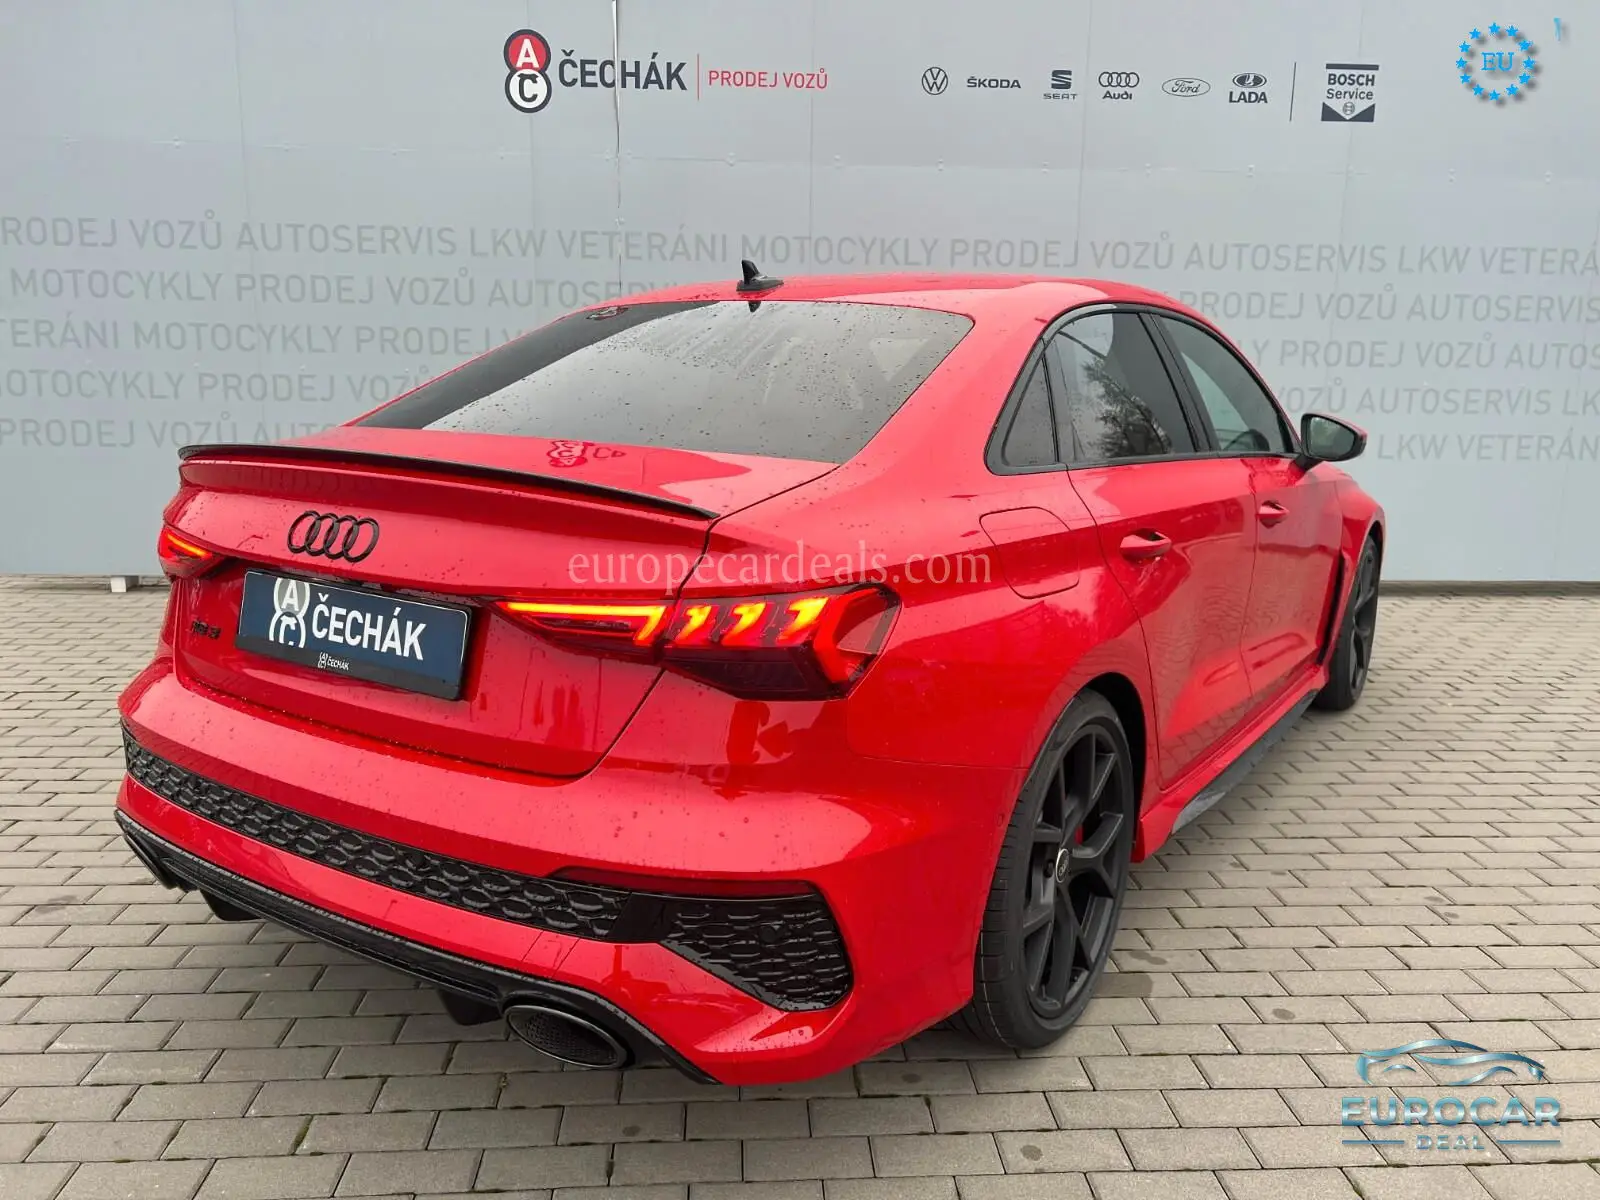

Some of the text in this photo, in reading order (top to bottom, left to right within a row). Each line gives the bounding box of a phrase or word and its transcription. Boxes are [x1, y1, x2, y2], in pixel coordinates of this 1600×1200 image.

[557, 49, 688, 91] ČECHÁK
[708, 67, 829, 90] PRODEJ VOZŮ
[966, 75, 1021, 89] ŠKODA
[1327, 73, 1376, 87] BOSCH
[1043, 92, 1078, 100] SEAT
[1102, 90, 1133, 100] Audi
[1171, 80, 1201, 94] Ford
[1228, 91, 1269, 103] LADA
[1325, 88, 1374, 100] Service
[128, 208, 224, 250] VOZŮ
[236, 221, 457, 257] AUTOSERVIS
[468, 226, 547, 259] LKW
[556, 223, 728, 263] VETERÁNI
[740, 232, 939, 269] MOTOCYKLY
[949, 237, 1080, 270] PRODEJ
[1089, 231, 1174, 271] VOZŮ
[1183, 242, 1388, 274] AUTOSERVIS
[1398, 245, 1472, 275] LKW
[10, 268, 224, 303] MOTOCYKLY
[235, 273, 375, 305] PRODEJ
[385, 266, 475, 307] VOZŮ
[1315, 284, 1398, 321] VOZŮ
[1405, 295, 1600, 323] AUTOSERVIS
[0, 312, 120, 350] ERÁNI
[132, 321, 343, 354] MOTOCYKLY
[355, 326, 491, 357] PRODEJ
[1277, 339, 1404, 369] PRODEJ
[1415, 332, 1497, 370] VOZŮ
[0, 369, 185, 401] OTOCYKLY
[199, 373, 336, 402] PRODEJ
[1277, 377, 1348, 413] OZŮ
[1355, 388, 1553, 416] AUTOSERVIS
[0, 418, 136, 449] PRODEJ
[147, 411, 237, 450] VOZŮ
[1377, 432, 1447, 462] LKW
[312, 592, 428, 661] ČECHÁK
